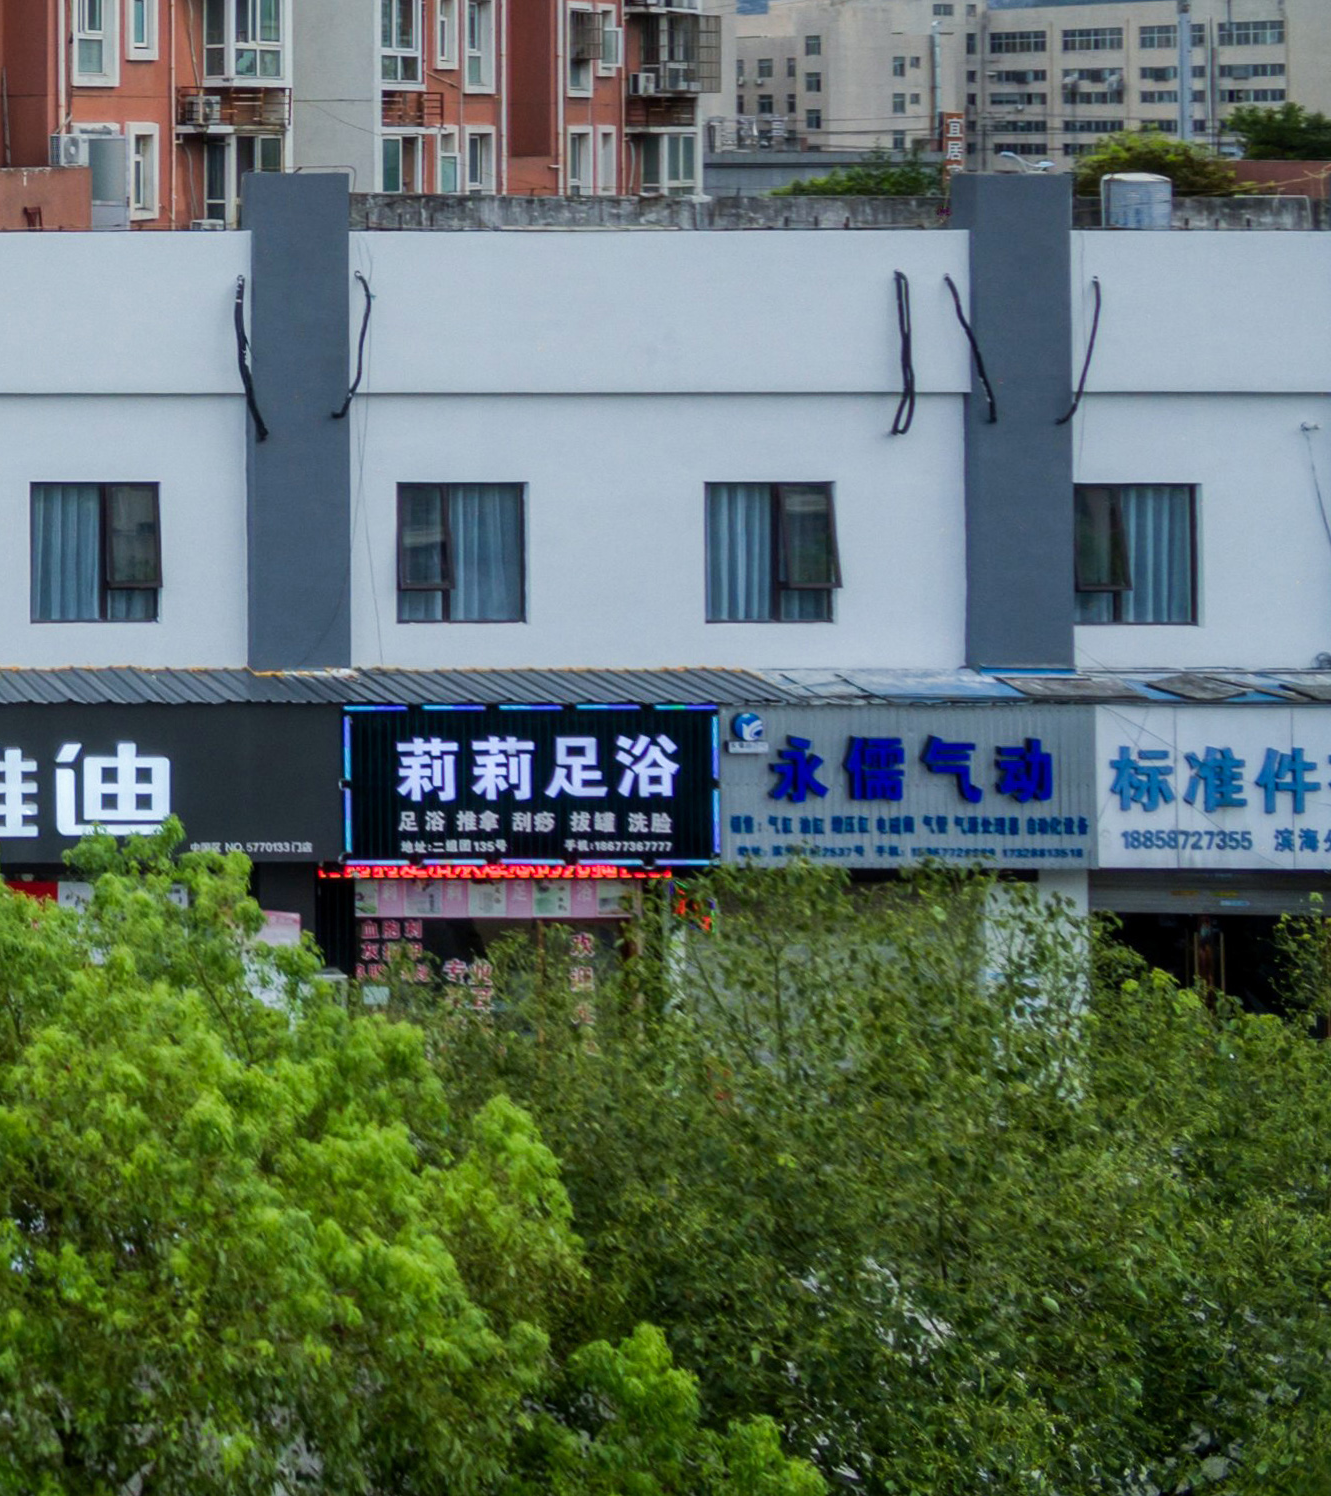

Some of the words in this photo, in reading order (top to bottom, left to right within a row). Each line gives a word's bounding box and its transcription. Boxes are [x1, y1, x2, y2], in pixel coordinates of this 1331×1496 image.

[395, 733, 681, 802] 莉莉足浴
[767, 734, 1055, 804] 永儒气动
[1108, 745, 1331, 815] 标准件
[398, 810, 446, 833] 足浴
[456, 810, 500, 834] 推拿
[512, 811, 556, 834] 刮痧
[569, 811, 616, 834] 拔罐
[628, 811, 673, 834] 洗脸
[1121, 829, 1253, 851] 18858727355
